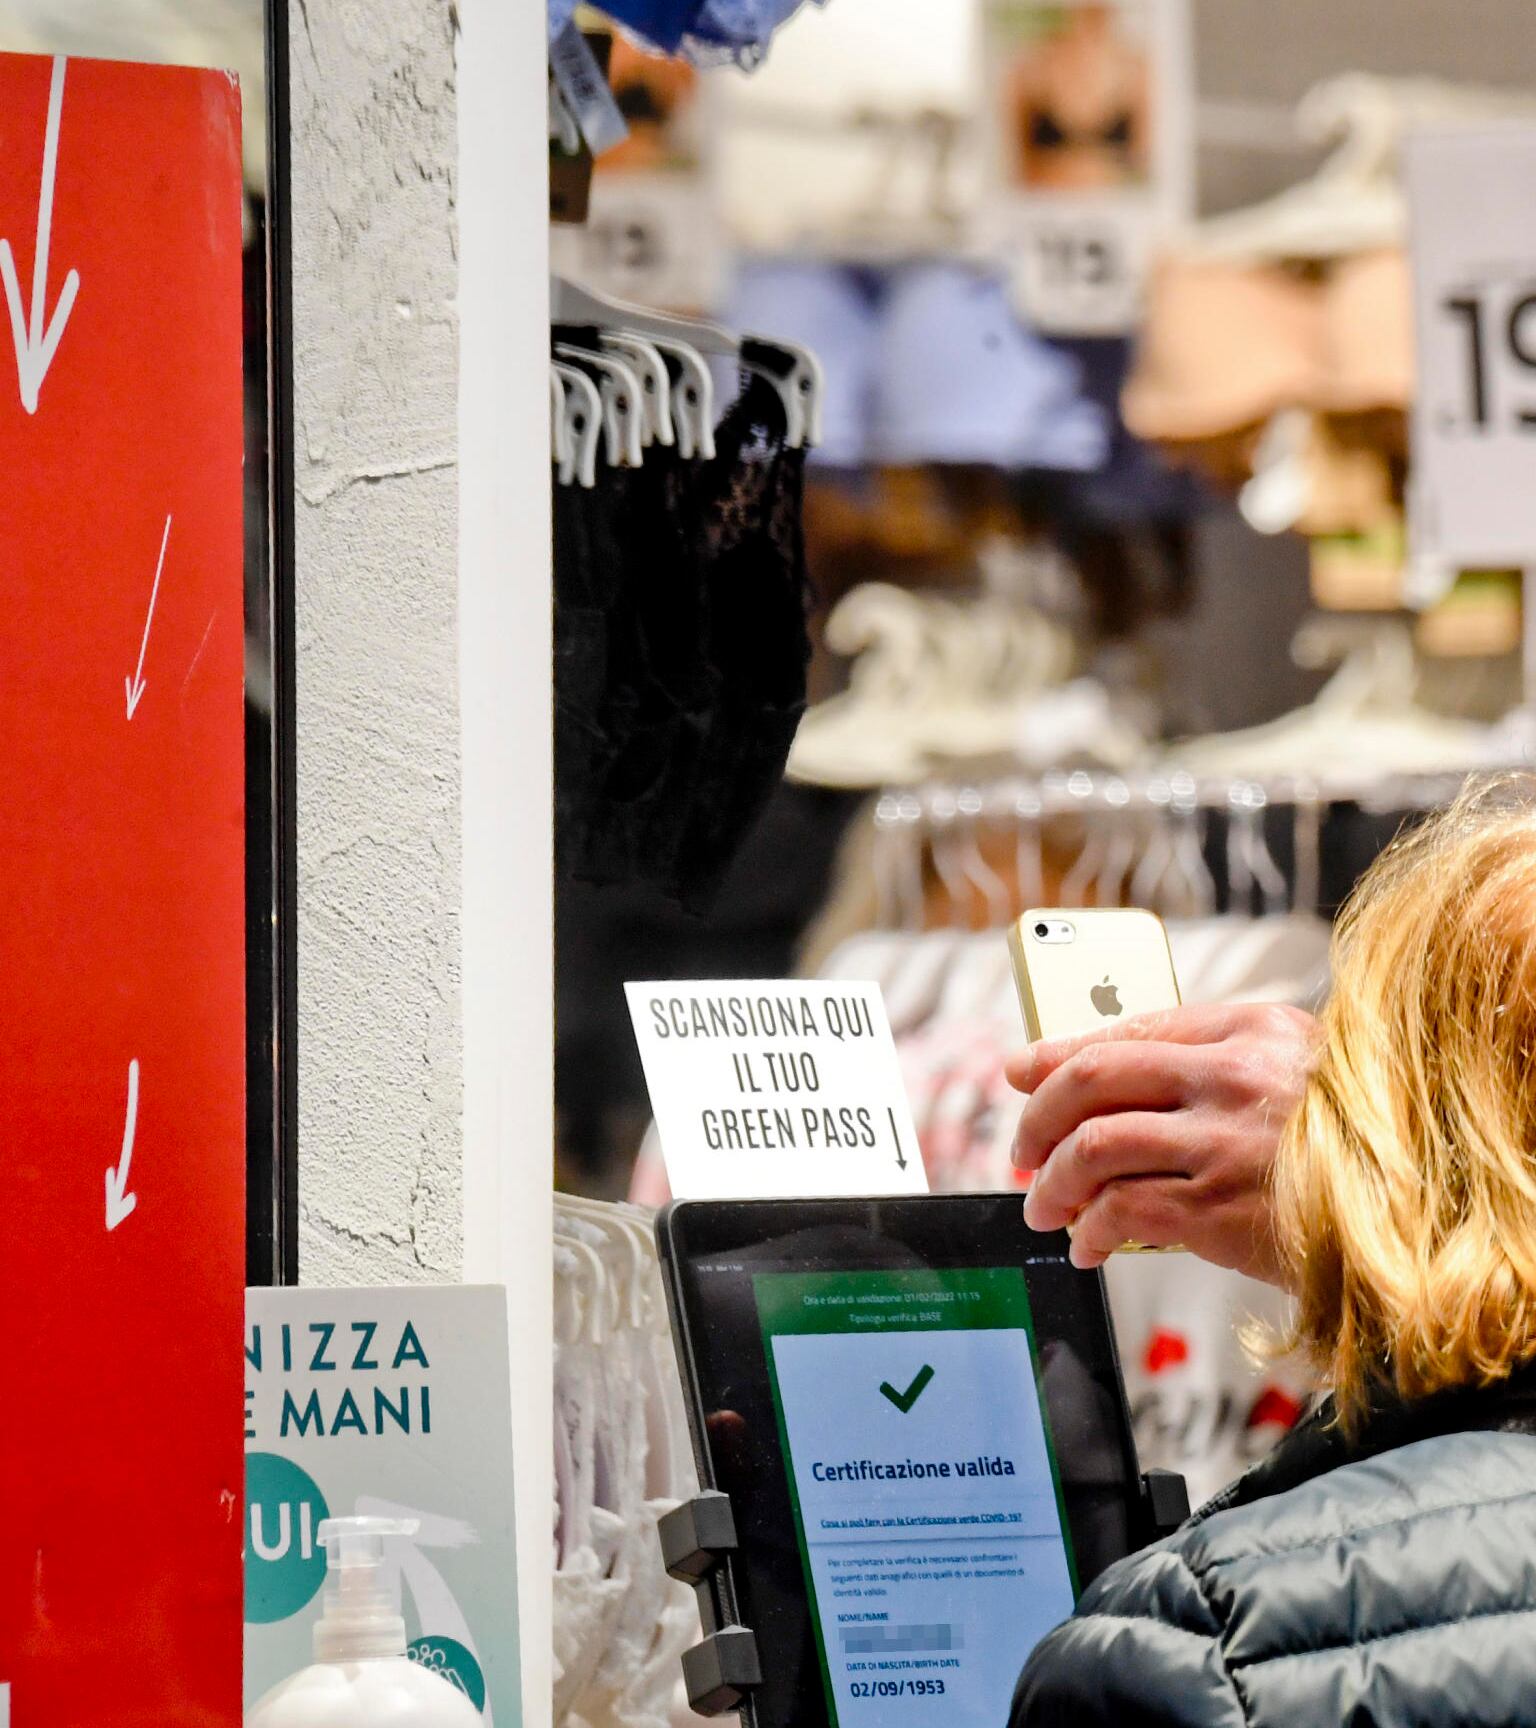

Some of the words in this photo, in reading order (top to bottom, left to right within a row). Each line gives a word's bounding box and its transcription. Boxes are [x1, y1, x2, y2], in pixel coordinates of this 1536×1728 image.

[650, 997, 819, 1038] SCANSIONA
[823, 997, 875, 1042] QUI
[732, 1053, 762, 1092] IL
[763, 1052, 819, 1092] TUO
[701, 1108, 797, 1150] GREEN
[801, 1107, 876, 1148] PASS
[280, 1386, 431, 1438] MANI
[812, 1459, 950, 1482] Certificazione
[955, 1456, 1015, 1477] valida
[838, 1611, 889, 1622] NOME/NAME
[846, 1661, 867, 1672] DATA
[868, 1661, 877, 1671] DI
[878, 1658, 938, 1671] NASCITA/BIRTH
[940, 1657, 960, 1668] DATE
[850, 1679, 946, 1698] 02/09/1953
